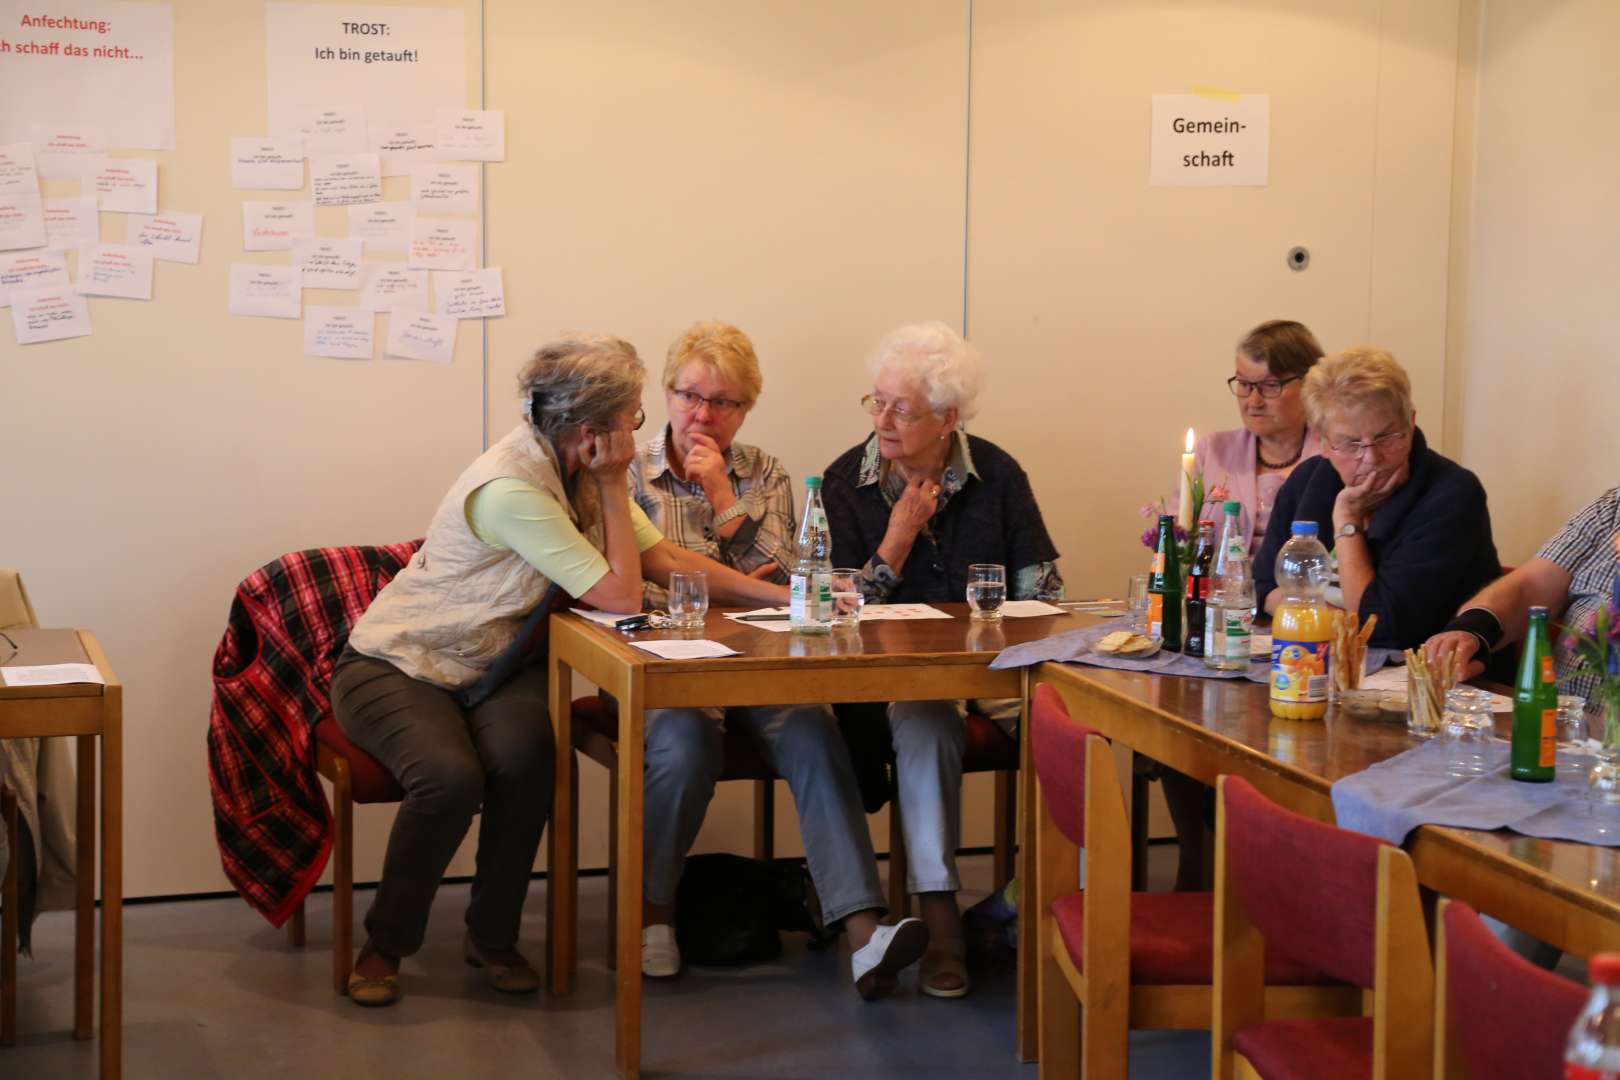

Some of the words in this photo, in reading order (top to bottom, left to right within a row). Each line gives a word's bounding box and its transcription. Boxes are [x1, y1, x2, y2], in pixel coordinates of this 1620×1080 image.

[21, 14, 111, 34] Anfechtung:
[342, 22, 391, 36] TROST:
[16, 41, 59, 56] schaff
[64, 43, 89, 57] das
[93, 45, 144, 60] nicht...
[315, 47, 335, 60] Ich
[339, 47, 361, 61] bin
[364, 49, 419, 64] getauft!
[1172, 117, 1247, 134] Gemein-
[1183, 150, 1235, 168] schaft
